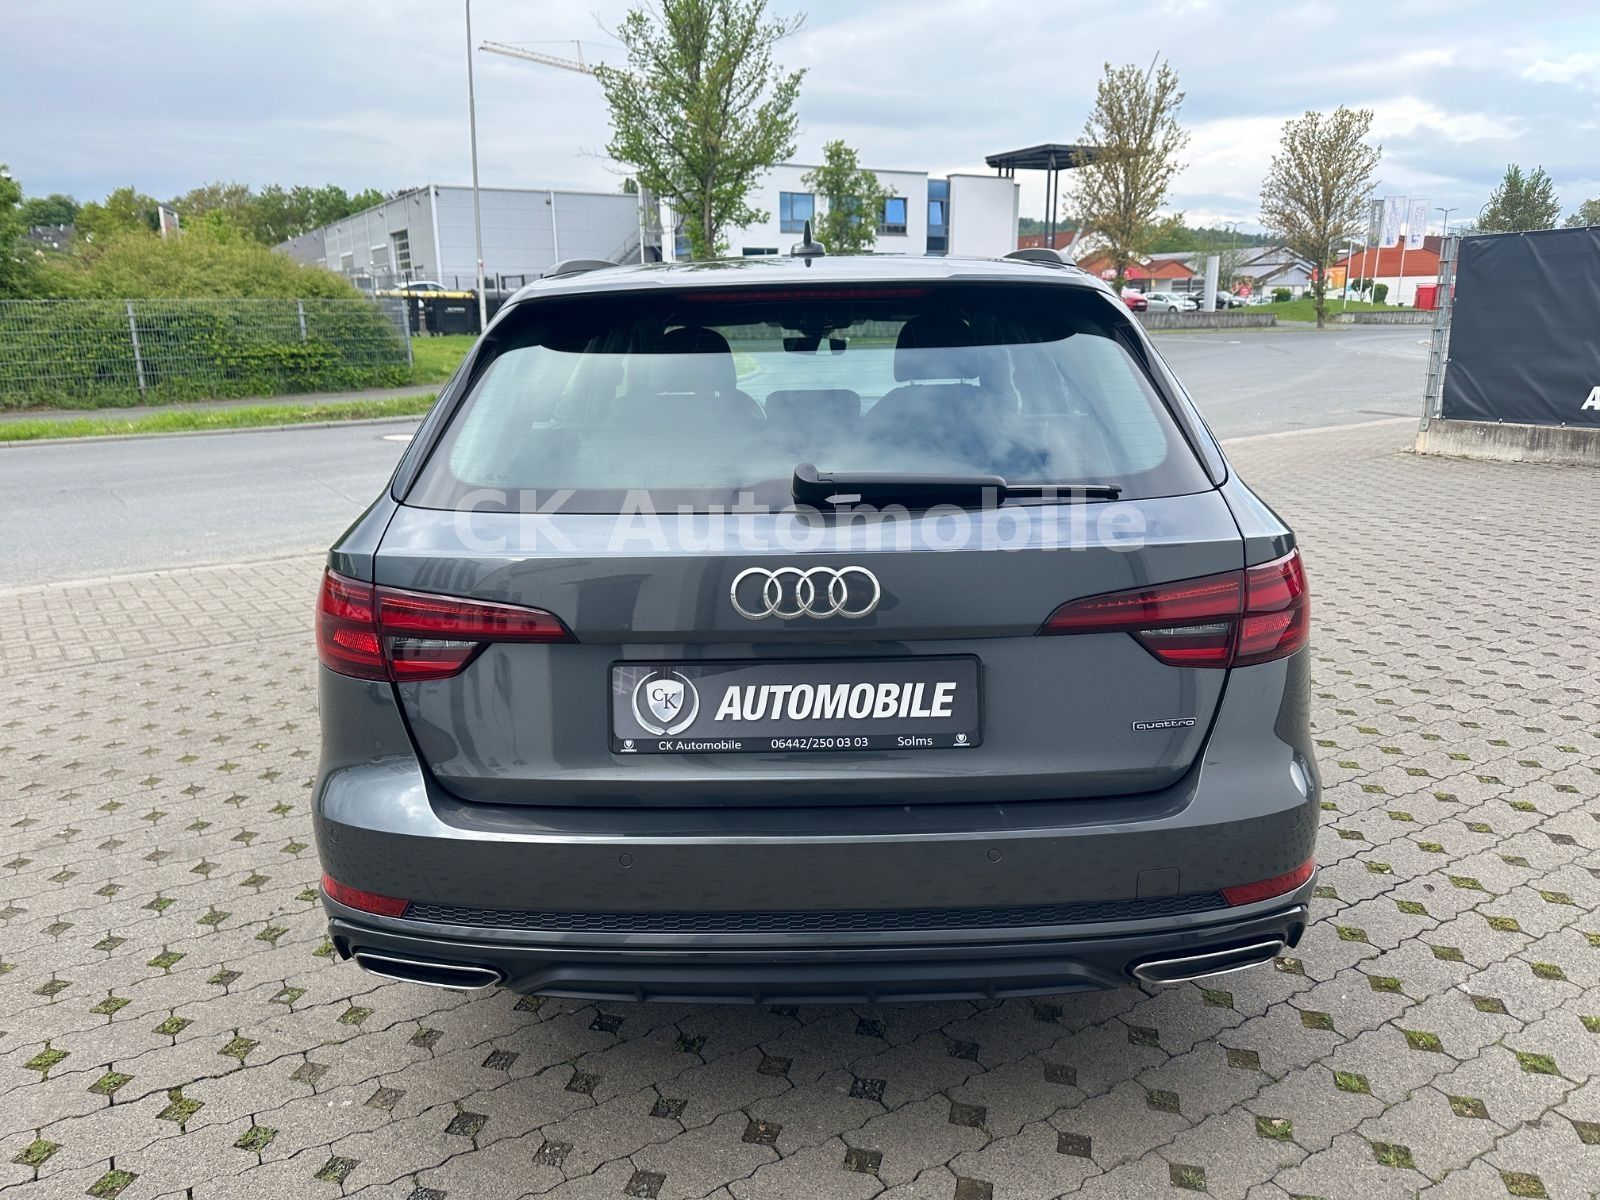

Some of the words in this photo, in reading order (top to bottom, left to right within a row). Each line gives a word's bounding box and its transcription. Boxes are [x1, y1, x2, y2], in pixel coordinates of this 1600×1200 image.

[652, 688, 678, 709] CK
[714, 682, 956, 721] AUTOMOBILE
[1136, 720, 1195, 731] quattro
[658, 741, 673, 750] CK
[675, 740, 742, 750] Automobile
[771, 737, 834, 749] 06442/250
[836, 738, 850, 747] 03
[854, 737, 869, 747] 03
[897, 736, 933, 746] Solms
